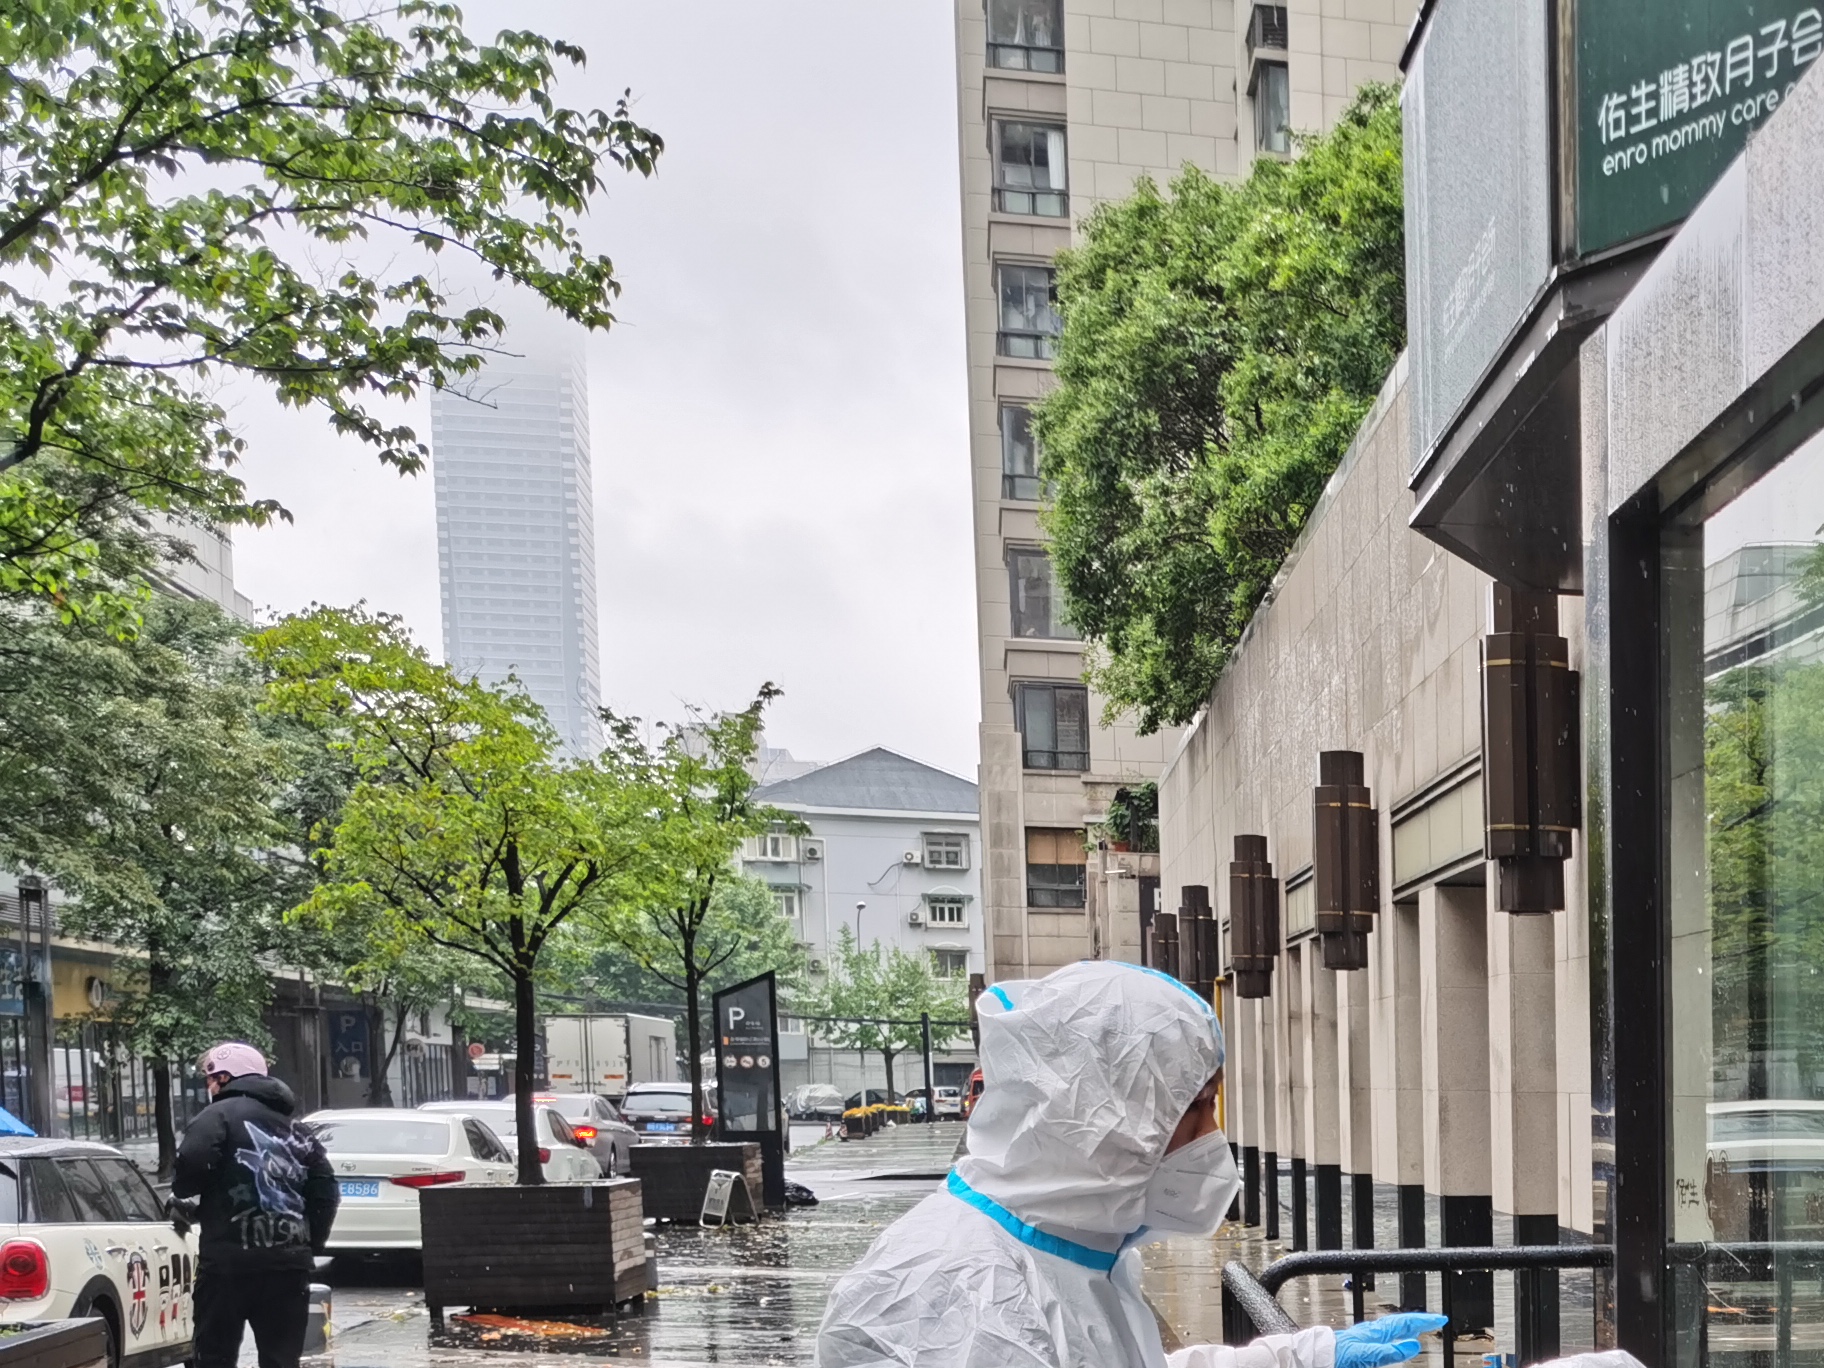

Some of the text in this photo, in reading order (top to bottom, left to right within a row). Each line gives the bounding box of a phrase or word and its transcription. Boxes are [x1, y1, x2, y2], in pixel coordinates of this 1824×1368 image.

[1602, 143, 1648, 177] enro
[1652, 110, 1727, 160] mommy
[1731, 88, 1780, 126] care
[728, 1007, 745, 1030] P
